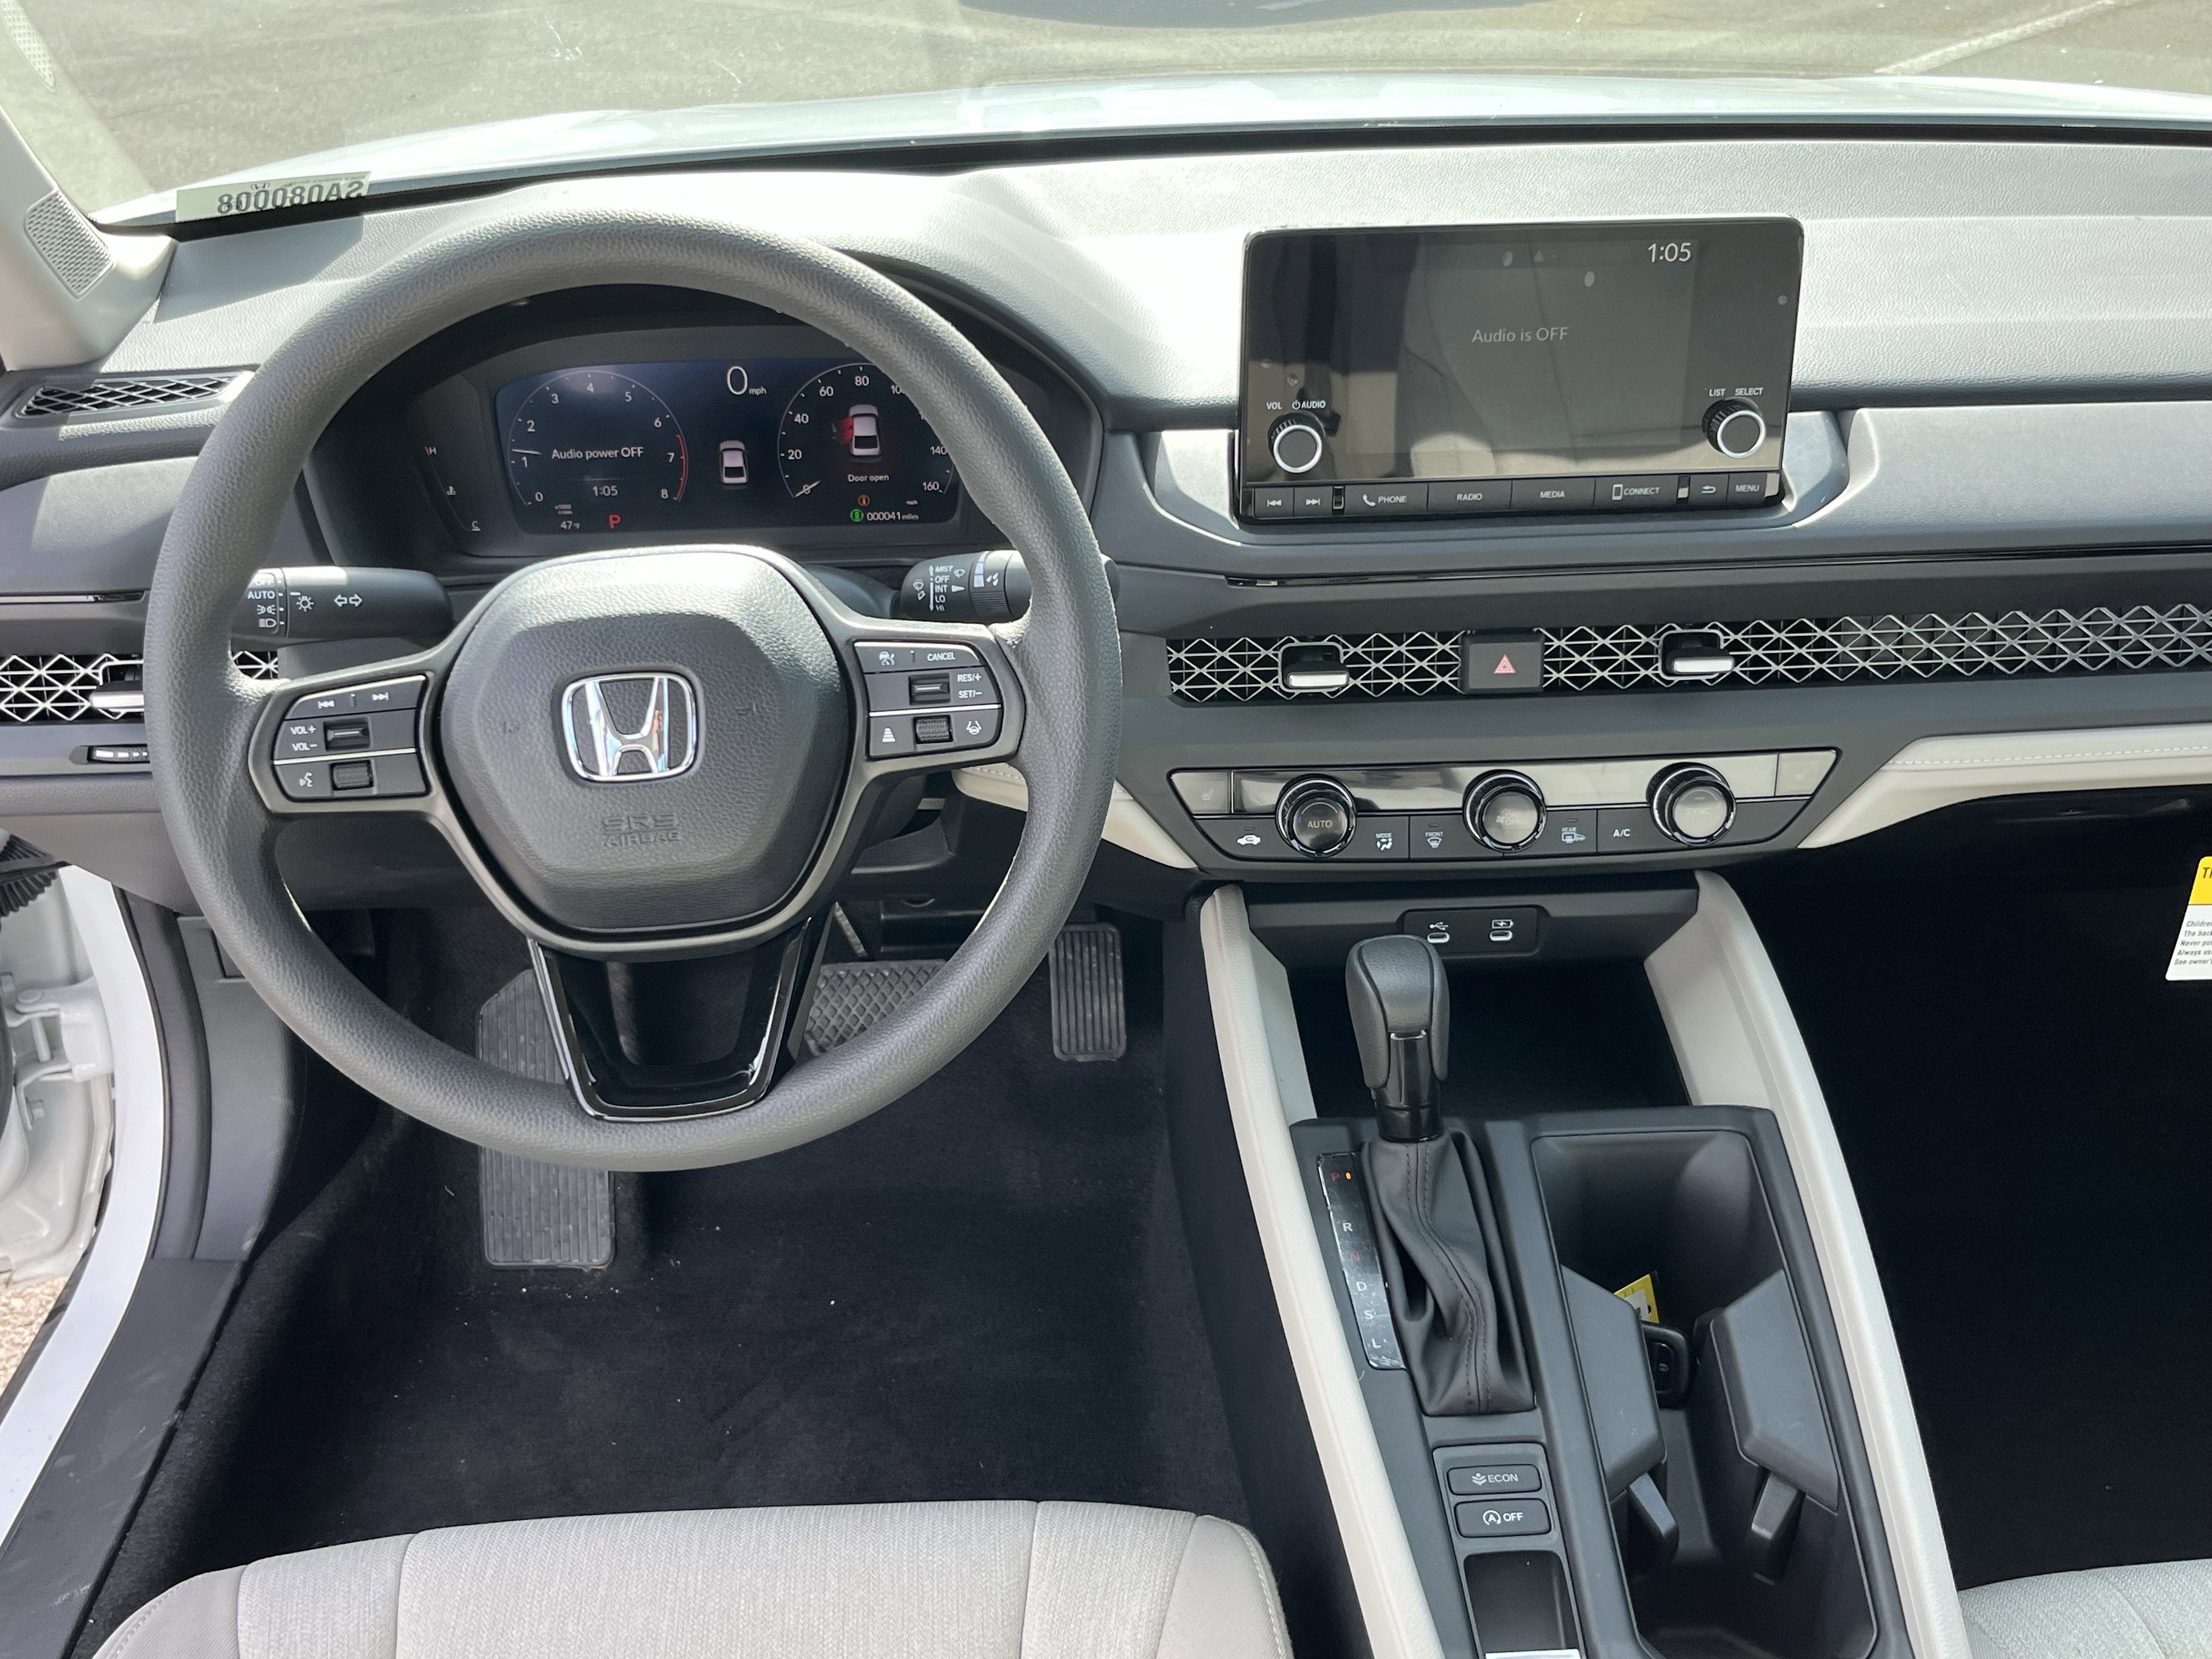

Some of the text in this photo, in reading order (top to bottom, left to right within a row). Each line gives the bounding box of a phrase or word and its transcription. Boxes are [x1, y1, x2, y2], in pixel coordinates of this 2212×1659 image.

[1647, 242, 1691, 263] 1:05
[1472, 327, 1568, 343] Audio is OFF
[727, 366, 767, 396] 0 mph
[855, 376, 870, 386] 80
[586, 383, 594, 393] 4
[819, 387, 833, 396] 60
[890, 385, 904, 395] 10
[1709, 388, 1726, 397] LIST
[1735, 387, 1763, 396] SELECT
[551, 394, 559, 404] 3
[625, 391, 632, 402] 5
[1266, 401, 1283, 410] VOL
[1301, 399, 1326, 409] AUDIO
[654, 417, 662, 427] 6
[794, 414, 809, 424] 40
[527, 420, 535, 432] 2
[552, 447, 644, 461] Audio power OFF
[667, 453, 675, 463] 7
[788, 450, 802, 459] 20
[522, 456, 528, 467] 1
[848, 473, 889, 483] Door open
[592, 486, 618, 496] 1:05
[922, 482, 939, 491] 160
[1623, 486, 1660, 496] CONNECT
[1735, 483, 1760, 493] MENU
[534, 492, 543, 502] 0
[661, 489, 668, 499] 8
[1457, 493, 1482, 502] RADIO
[1540, 489, 1565, 499] MEDIA
[1378, 495, 1407, 505] PHONE
[867, 511, 901, 521] 000041
[609, 515, 621, 529] P
[934, 575, 950, 584] OFF
[935, 584, 948, 593] INT
[247, 590, 275, 600] AUTO
[927, 651, 956, 662] CANCEL
[1307, 820, 1333, 829] AUTO
[1613, 828, 1630, 837] A/C
[1342, 1222, 1353, 1232] R
[1356, 1281, 1367, 1292] D
[1364, 1310, 1374, 1320] S
[1372, 1338, 1381, 1349] L
[1488, 1474, 1518, 1483] ECON
[1503, 1512, 1523, 1522] OFF
